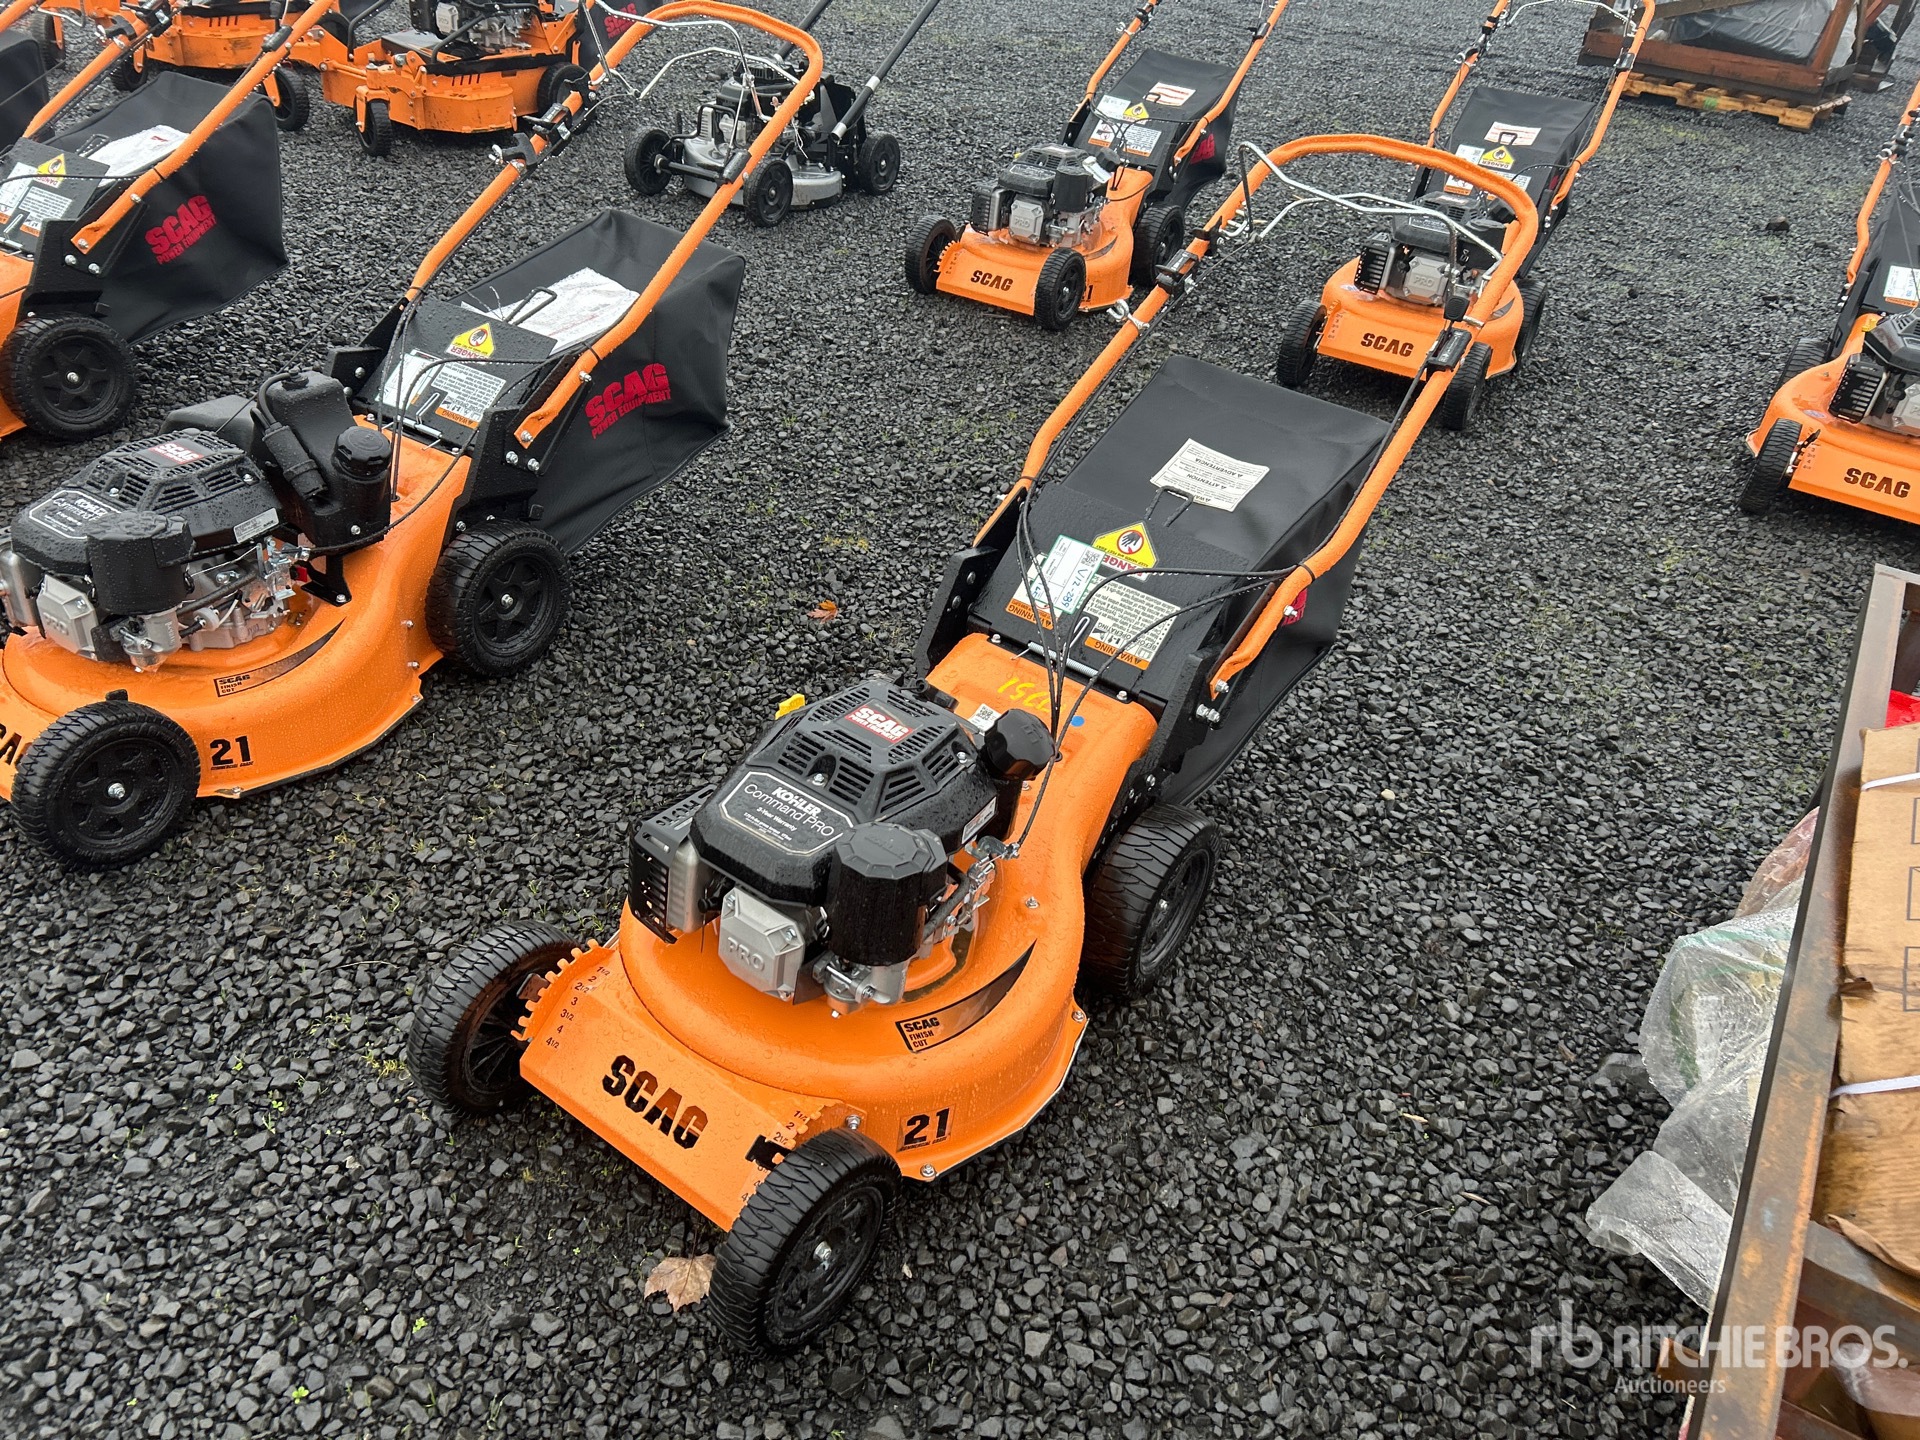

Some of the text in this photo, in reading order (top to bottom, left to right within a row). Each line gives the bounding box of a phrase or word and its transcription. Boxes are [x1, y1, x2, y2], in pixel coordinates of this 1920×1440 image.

[144, 195, 212, 254] SCAG
[156, 214, 217, 265] POWER EQUIPMENT
[970, 270, 1014, 292] SCAG
[1413, 275, 1435, 288] PRO
[1360, 332, 1414, 357] SCAG
[584, 362, 670, 427] SCAG
[441, 410, 469, 424] WARNING
[591, 389, 672, 439] POWER EQUIPMENT
[159, 442, 200, 461] SCAG
[1194, 457, 1237, 476] ADVERTENCIA
[1186, 473, 1221, 489] ATTENTION
[1843, 467, 1911, 499] SCAG
[1096, 621, 1132, 640] OPERATING
[1093, 640, 1135, 663] WANING
[218, 674, 251, 685] SCAG
[848, 713, 869, 726] POWER
[854, 705, 910, 738] SCAG
[209, 735, 251, 766] 21
[744, 784, 809, 822] Command
[802, 812, 835, 837] PRO
[771, 786, 822, 817] KOHLER
[772, 814, 798, 832] Warranty
[726, 936, 766, 973] PRO
[587, 975, 596, 983] 2
[570, 996, 578, 1006] 3
[556, 1025, 563, 1034] 4
[903, 1017, 940, 1033] SCAG
[909, 1030, 935, 1041] FINISH
[912, 1039, 928, 1048] CUT
[602, 1054, 709, 1150] SCAG
[785, 1121, 795, 1130] 2
[903, 1107, 950, 1146] 21
